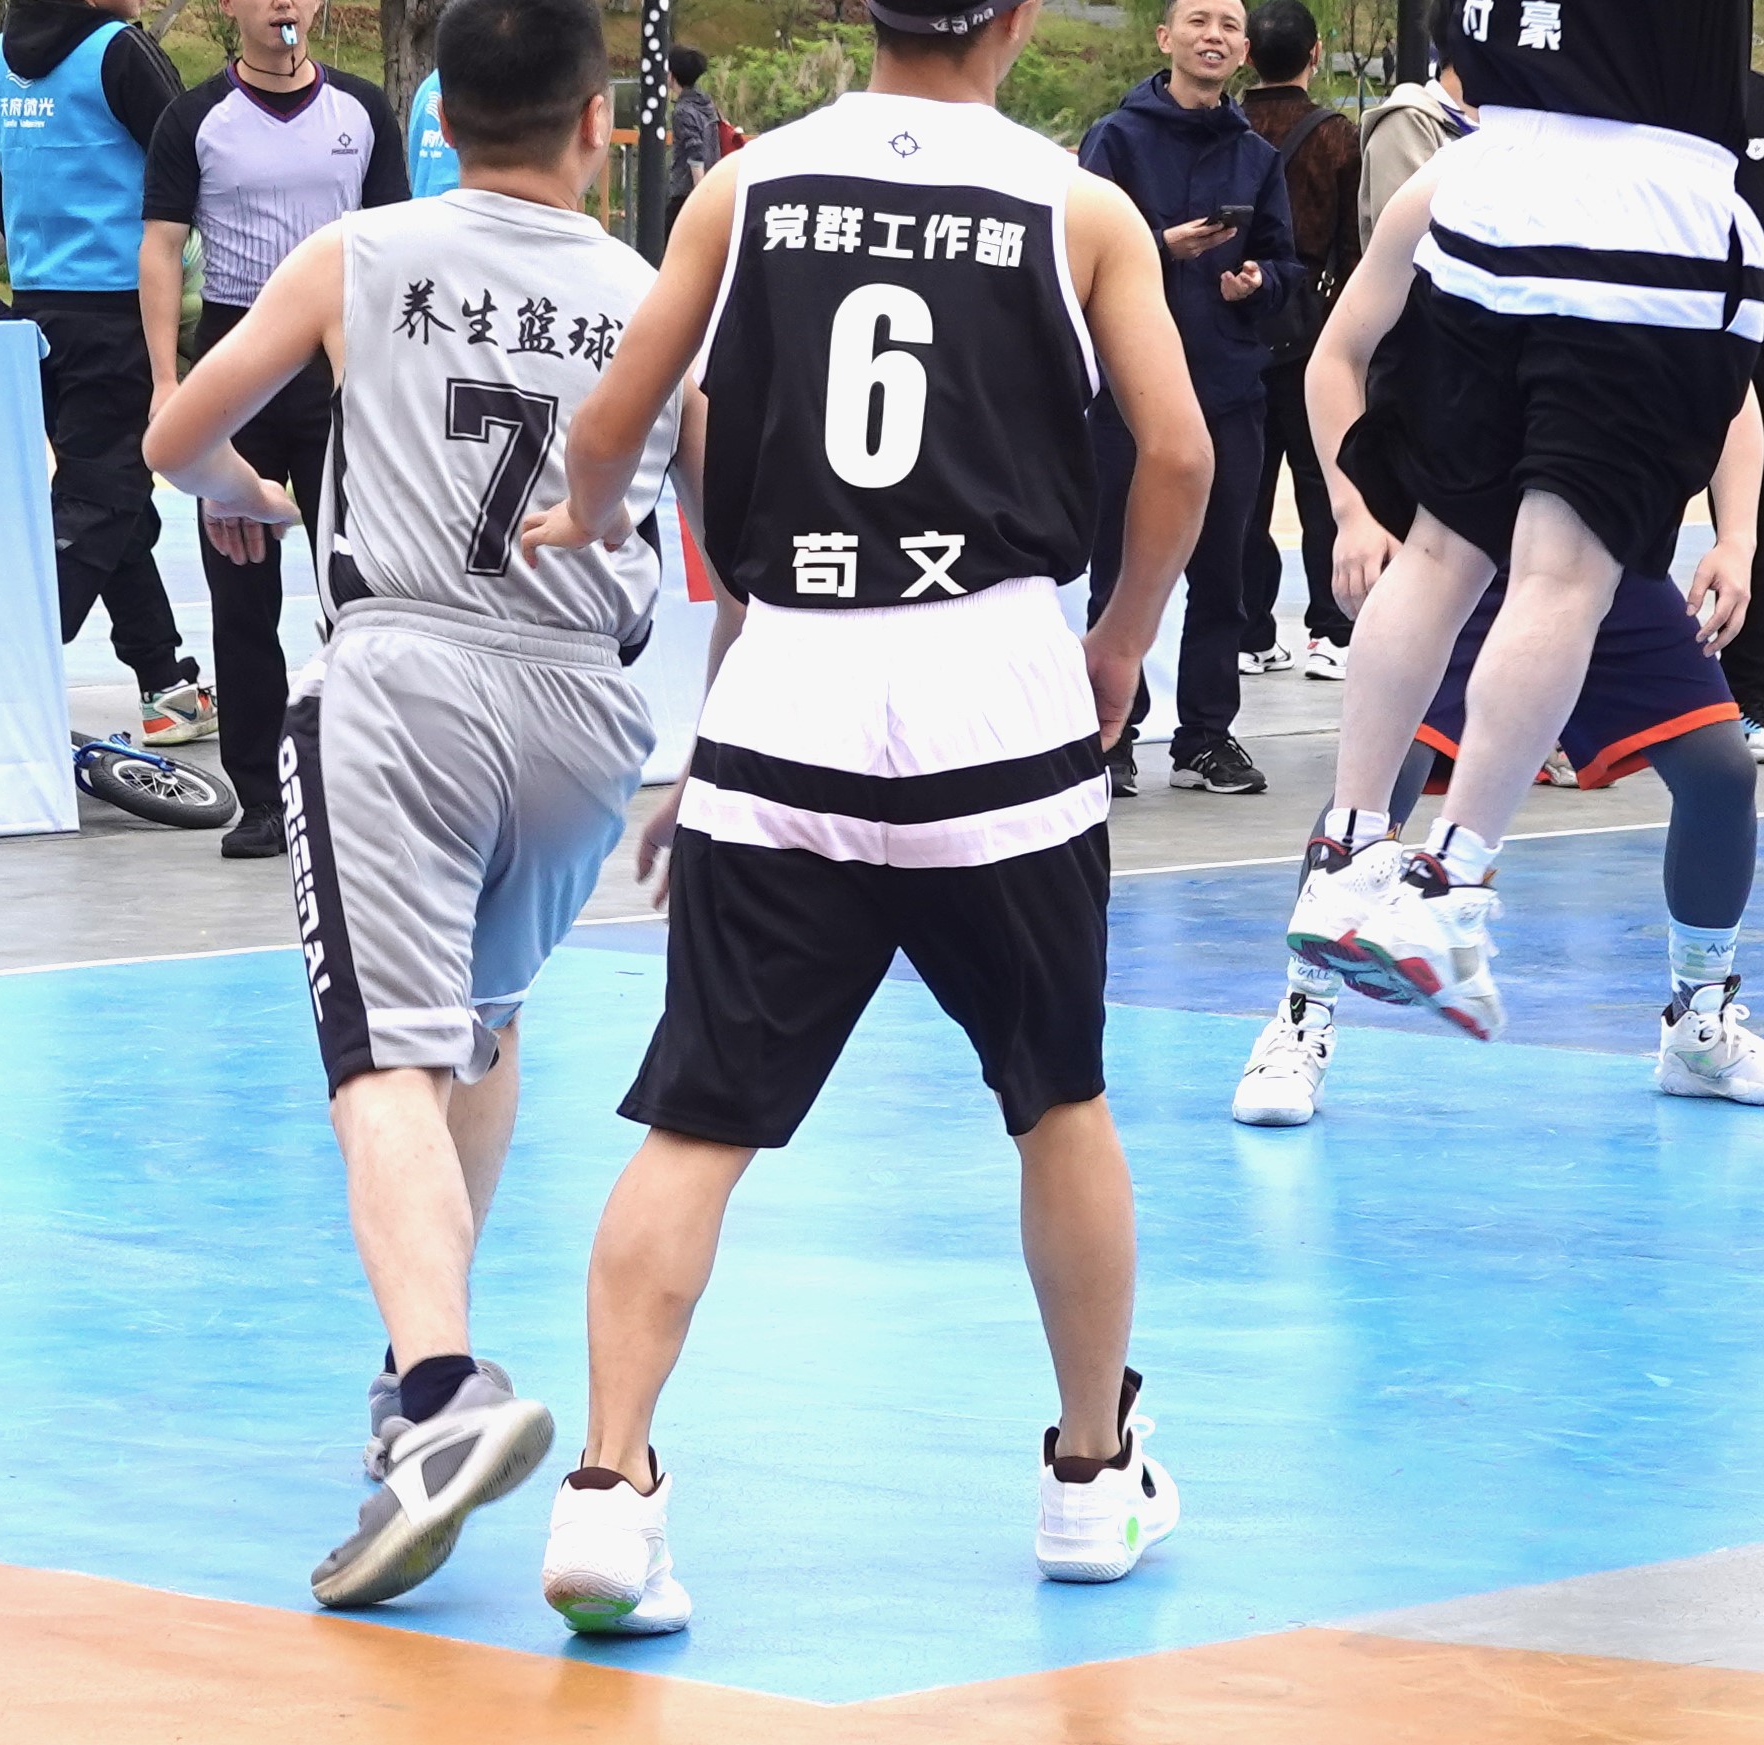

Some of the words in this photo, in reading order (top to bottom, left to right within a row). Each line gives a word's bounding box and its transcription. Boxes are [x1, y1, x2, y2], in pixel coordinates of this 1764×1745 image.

[763, 203, 1027, 268] 党群工作部
[392, 277, 625, 373] 养生篮球
[825, 282, 933, 489] 6
[445, 377, 559, 577] 7
[791, 530, 969, 598] 苟文
